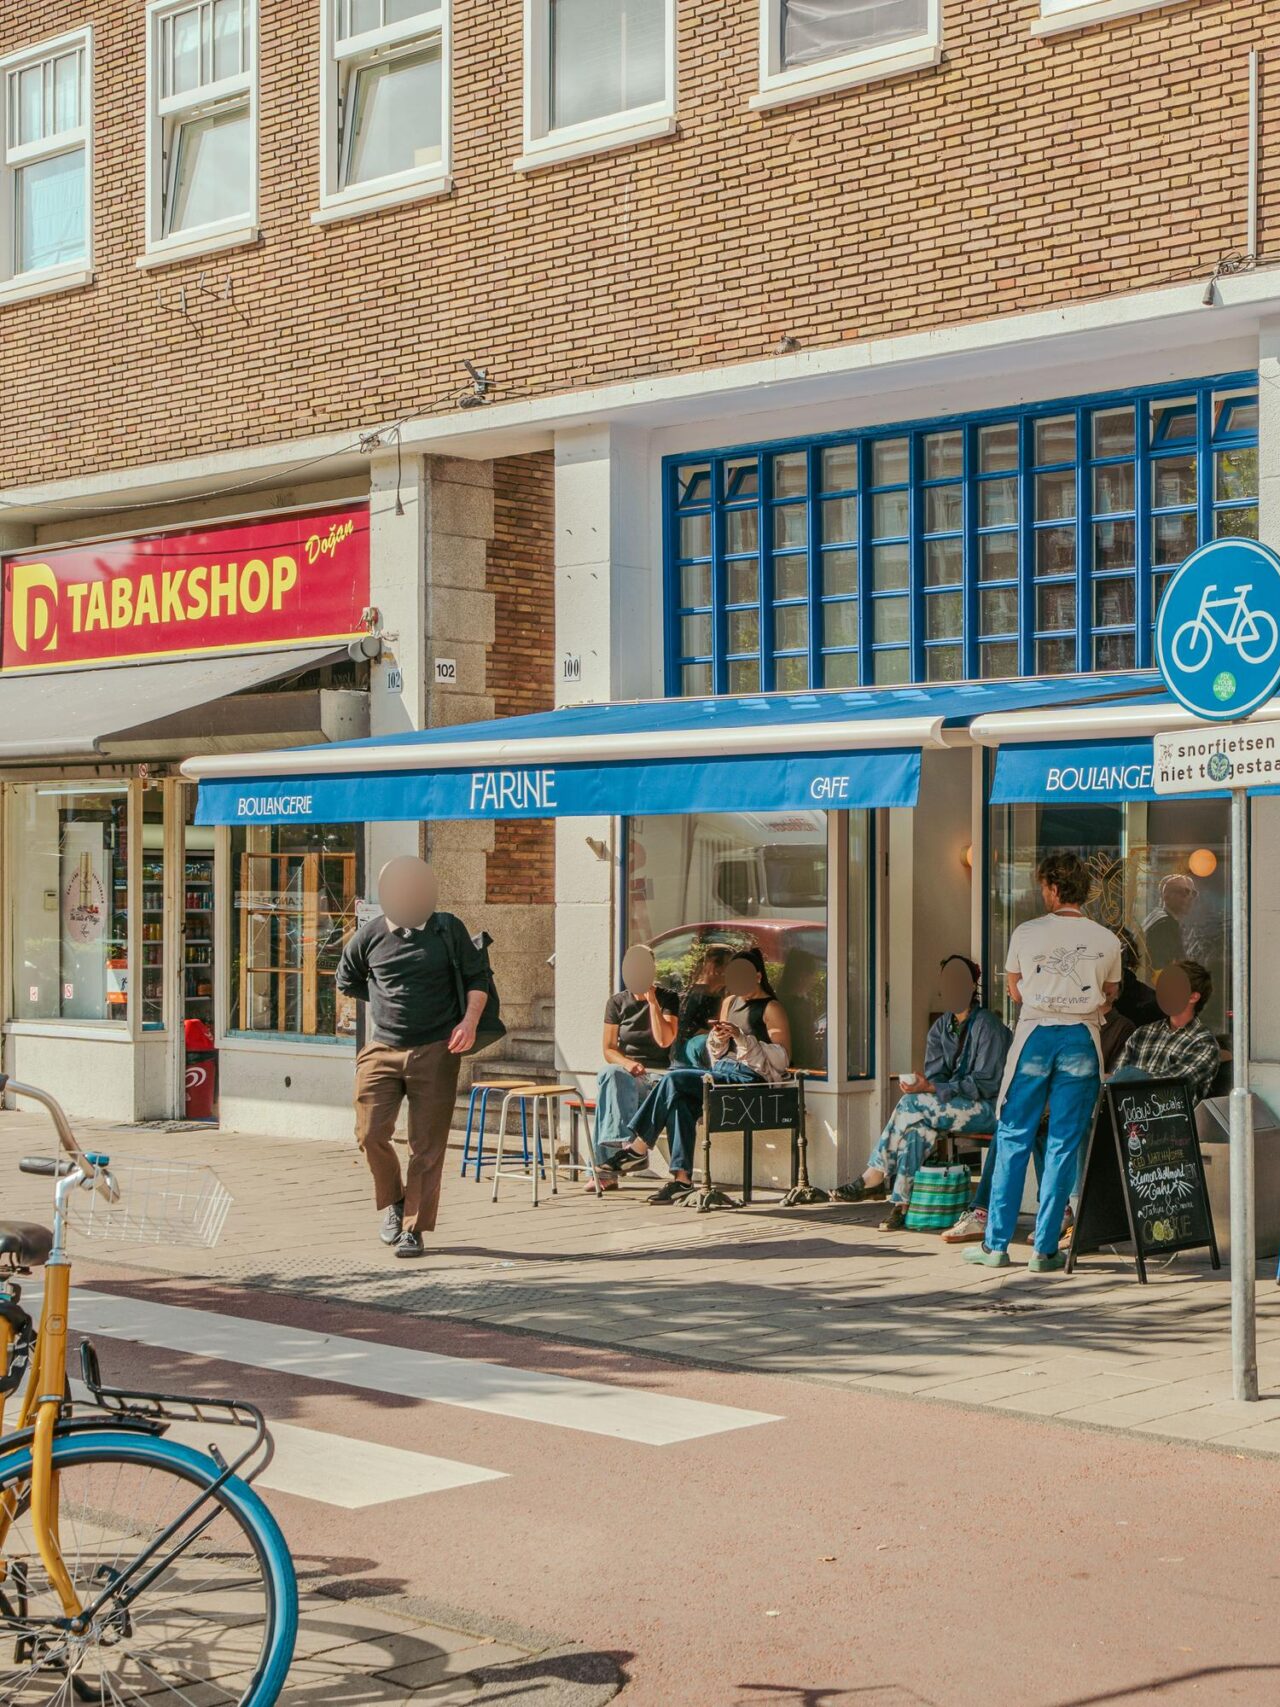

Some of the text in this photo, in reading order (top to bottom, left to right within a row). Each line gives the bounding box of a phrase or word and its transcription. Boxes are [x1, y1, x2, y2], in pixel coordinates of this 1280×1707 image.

[304, 519, 355, 565] Doğan
[67, 555, 299, 634] TABAKSHOP
[436, 663, 456, 678] 102
[563, 659, 580, 677] 100
[387, 670, 402, 690] 102
[1177, 736, 1275, 758] snorfietsen
[1046, 765, 1155, 791] BOULANGE
[1160, 765, 1193, 782] niet
[469, 769, 558, 811] FARINE
[237, 795, 313, 816] BOULANGERIE
[720, 1094, 783, 1126] EXIT
